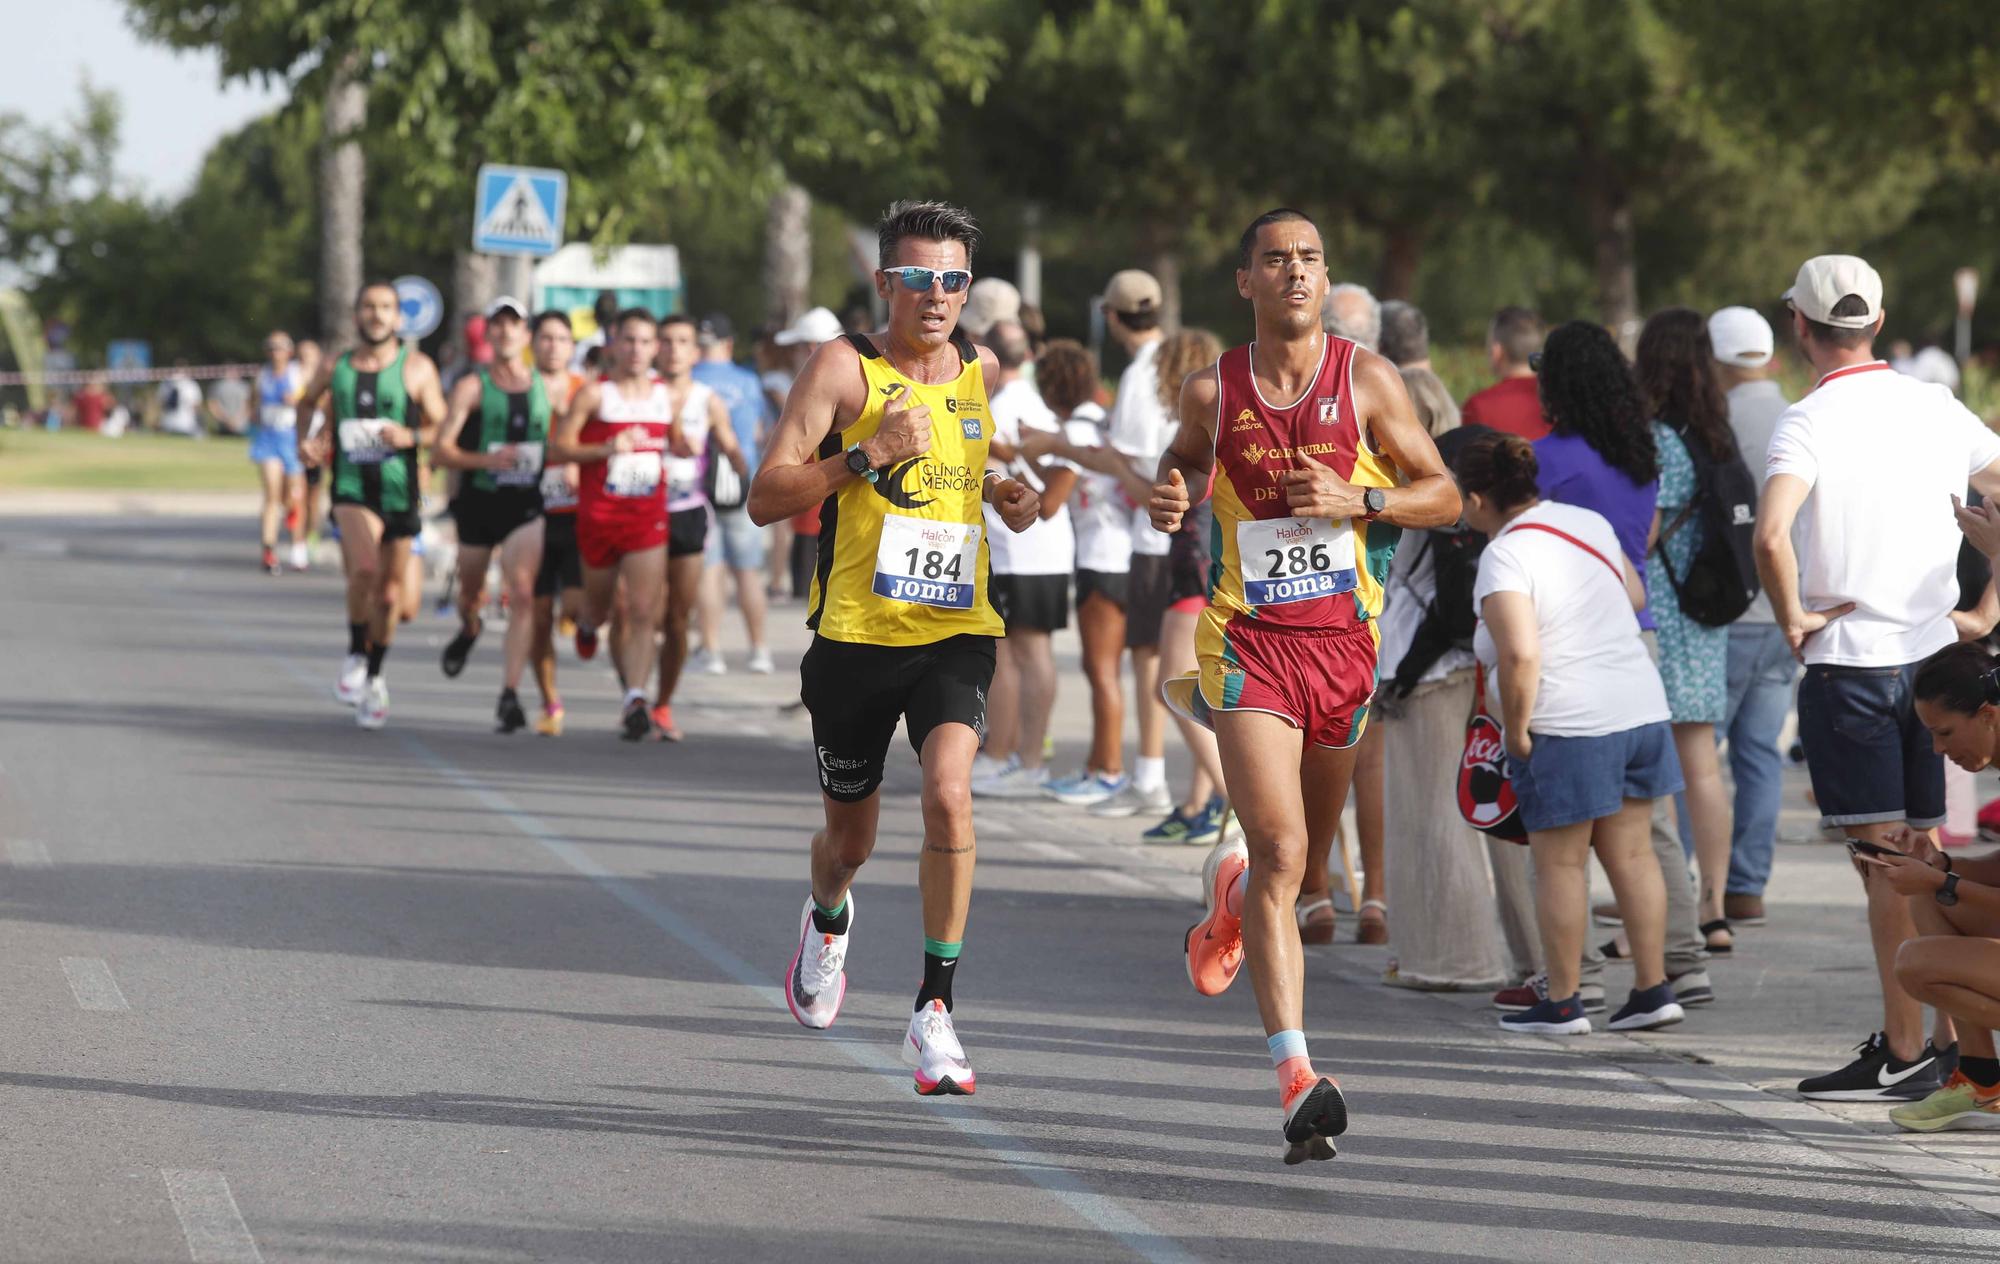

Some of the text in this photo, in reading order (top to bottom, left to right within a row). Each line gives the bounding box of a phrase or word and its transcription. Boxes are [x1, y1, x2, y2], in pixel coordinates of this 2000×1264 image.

[964, 422, 980, 435] ISC
[922, 462, 972, 478] CLÍNICA
[921, 477, 980, 491] MENORCA
[1254, 487, 1279, 500] DE
[905, 547, 962, 582] 184
[1265, 544, 1331, 578] 286
